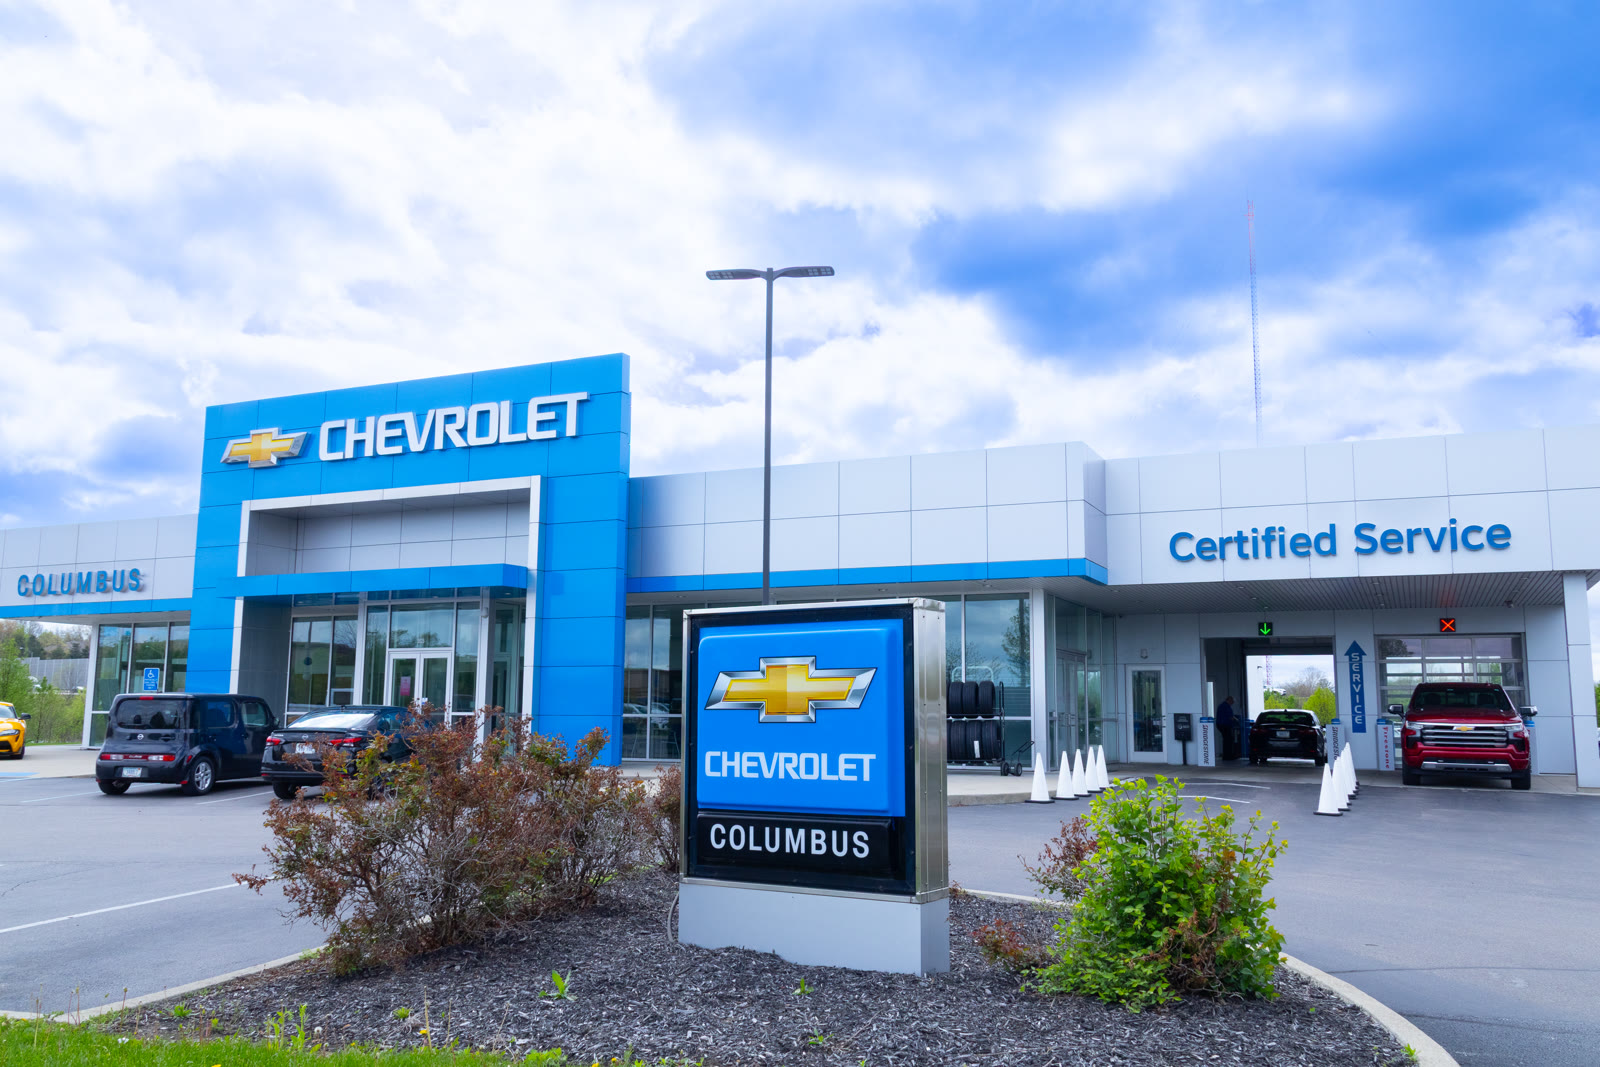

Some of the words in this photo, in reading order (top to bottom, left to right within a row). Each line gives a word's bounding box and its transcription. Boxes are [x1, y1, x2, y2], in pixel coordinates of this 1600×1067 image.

[319, 391, 590, 462] CHEVROLET
[1169, 523, 1338, 562] Certified
[1353, 518, 1512, 556] Service
[17, 567, 143, 598] COLUMBUS
[1350, 652, 1363, 725] SERVICE
[704, 750, 877, 782] CHEVROLET
[709, 822, 871, 859] COLUMBUS
